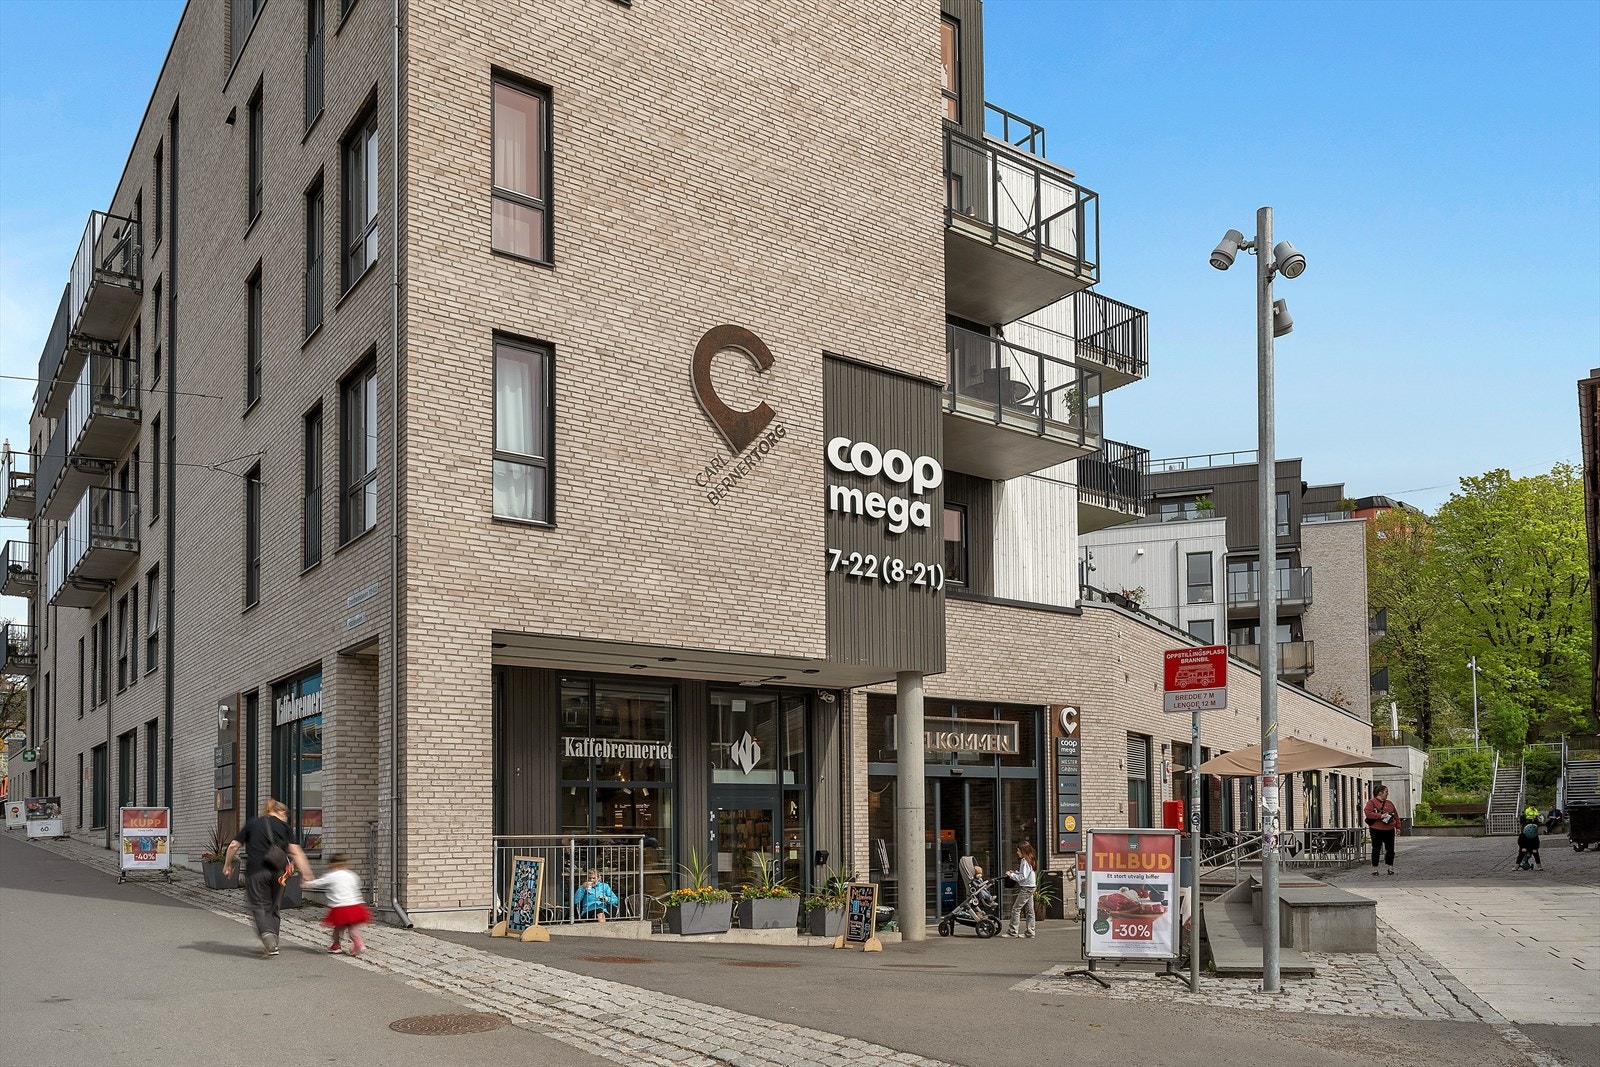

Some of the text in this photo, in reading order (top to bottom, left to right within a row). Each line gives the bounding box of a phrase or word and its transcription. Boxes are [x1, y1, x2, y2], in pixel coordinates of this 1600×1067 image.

[695, 454, 730, 488] CARL
[706, 424, 786, 507] BERNERTORG
[827, 436, 943, 495] coop
[829, 484, 931, 534] mega
[1166, 649, 1225, 659] OPPSTILLINGSPLASS
[276, 686, 322, 726] Kaffebrenneri
[564, 736, 674, 760] Kaffebrenneriet
[130, 818, 161, 827] KUPP
[1094, 852, 1172, 870] TILBUD
[1114, 924, 1151, 937] -30%
